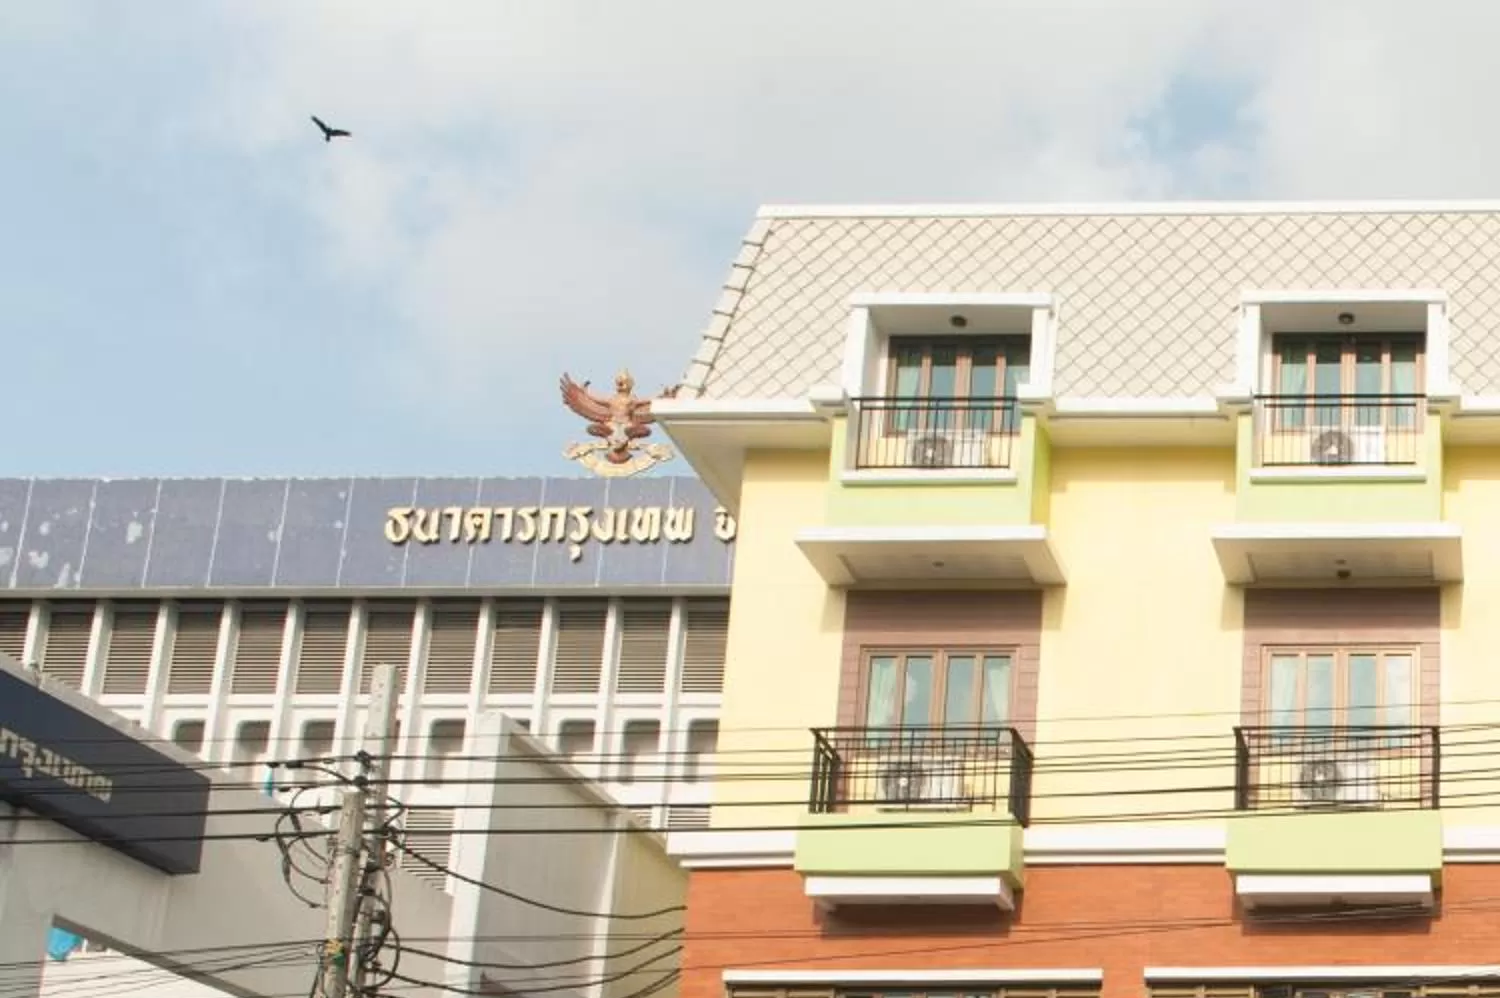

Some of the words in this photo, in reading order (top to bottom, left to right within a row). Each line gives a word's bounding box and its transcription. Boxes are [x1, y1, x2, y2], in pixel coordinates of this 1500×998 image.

[384, 505, 697, 562] ธนาคารกรุงเทพ
